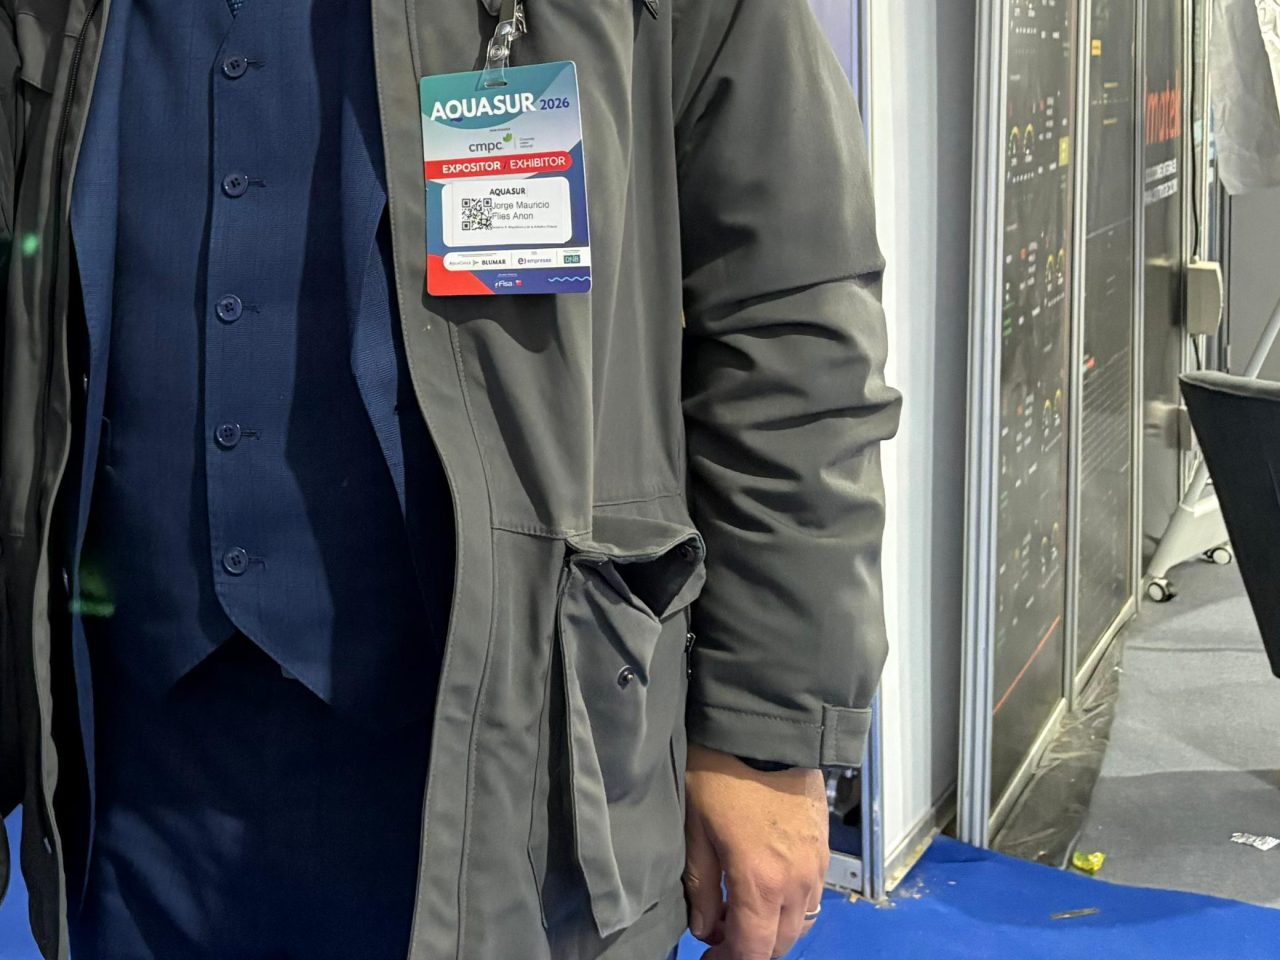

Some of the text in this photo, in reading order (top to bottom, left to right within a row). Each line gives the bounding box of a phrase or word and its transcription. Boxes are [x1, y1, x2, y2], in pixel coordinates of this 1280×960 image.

[430, 92, 569, 122] AQUASUR 2026
[442, 161, 501, 174] EXPOSITOR
[510, 156, 565, 169] EXHIBITOR
[489, 187, 526, 196] AQUASUR
[492, 202, 514, 210] Jorge
